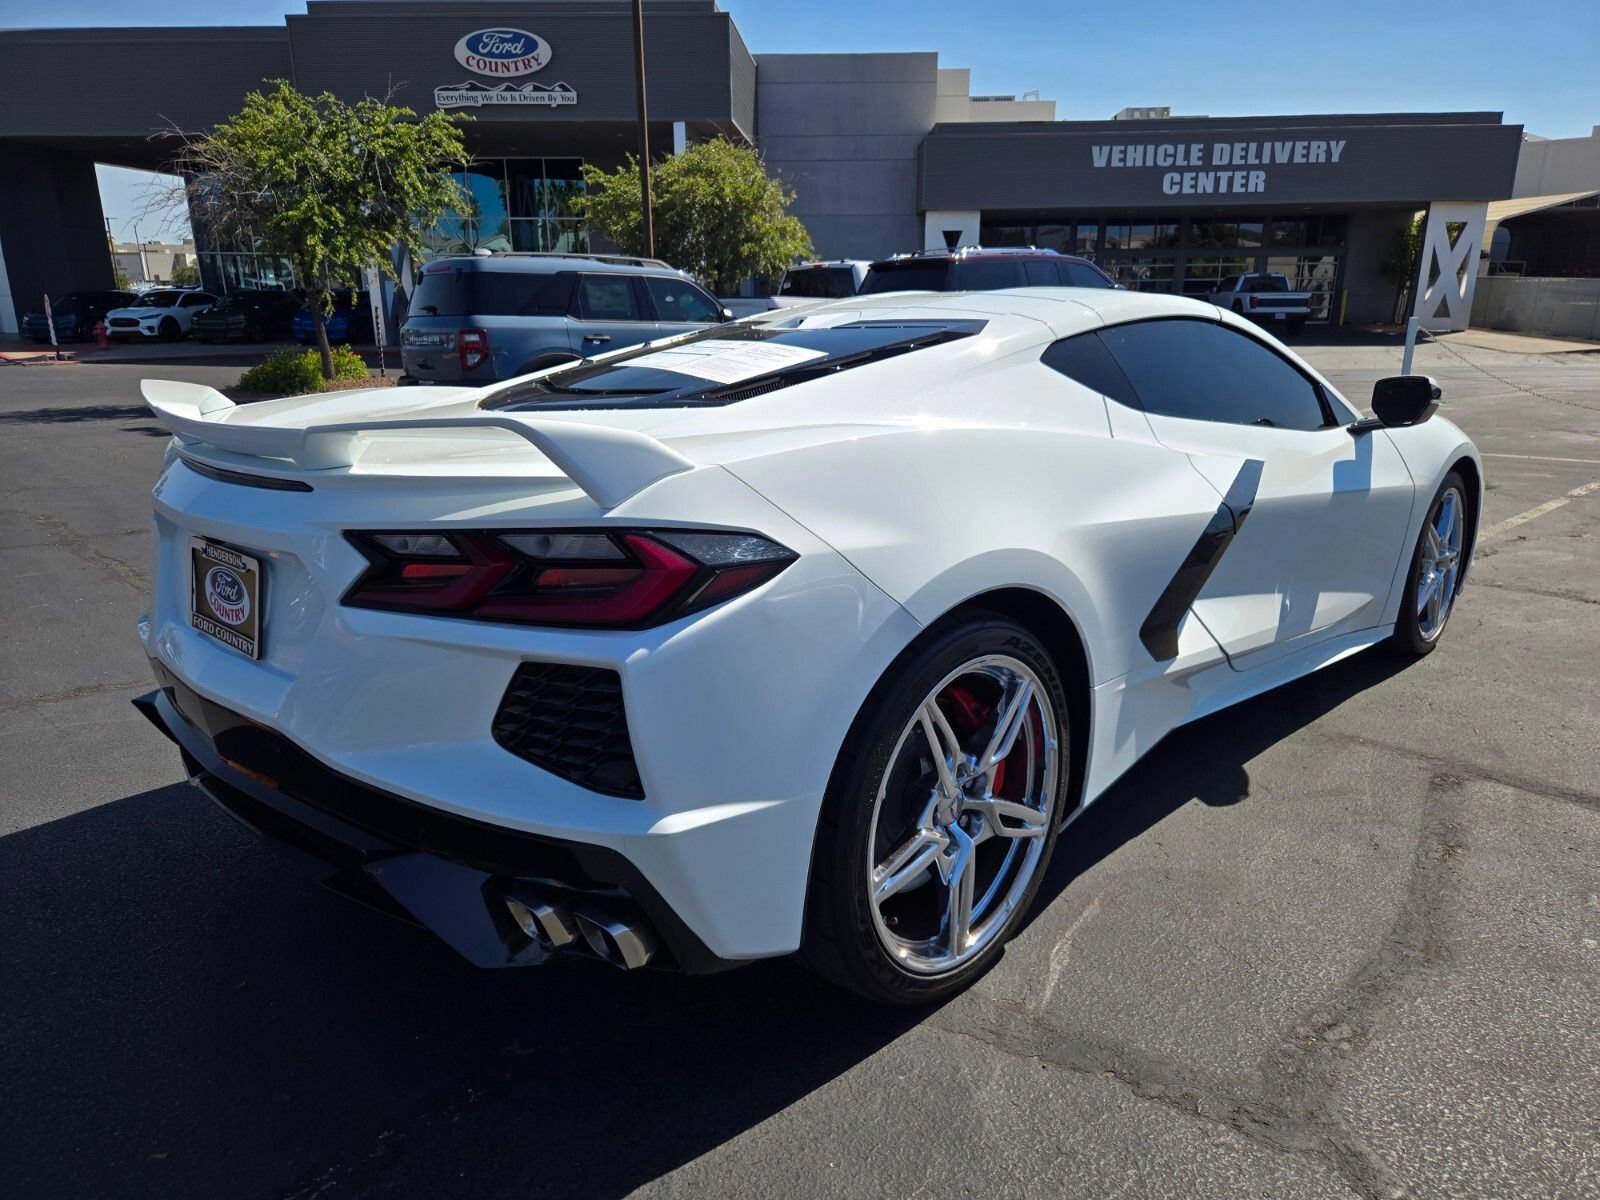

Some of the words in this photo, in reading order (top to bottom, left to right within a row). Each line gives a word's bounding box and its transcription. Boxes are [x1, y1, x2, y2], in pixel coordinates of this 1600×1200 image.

[479, 32, 526, 54] Ford
[465, 53, 542, 73] COUNTRY
[437, 92, 478, 104] Everything
[481, 93, 494, 102] We
[496, 93, 508, 102] Do
[510, 93, 516, 102] Is
[519, 93, 545, 102] Driven
[547, 93, 557, 104] By
[560, 93, 575, 102] You
[1091, 143, 1204, 168] VEHICLE
[1212, 140, 1347, 165] DELIVERY
[1162, 170, 1266, 194] CENTER
[205, 545, 242, 567] HENDERSON
[215, 572, 239, 601] Ford
[209, 591, 245, 622] COUNTRY
[193, 615, 215, 634] FORD
[215, 626, 255, 656] COUNTRY
